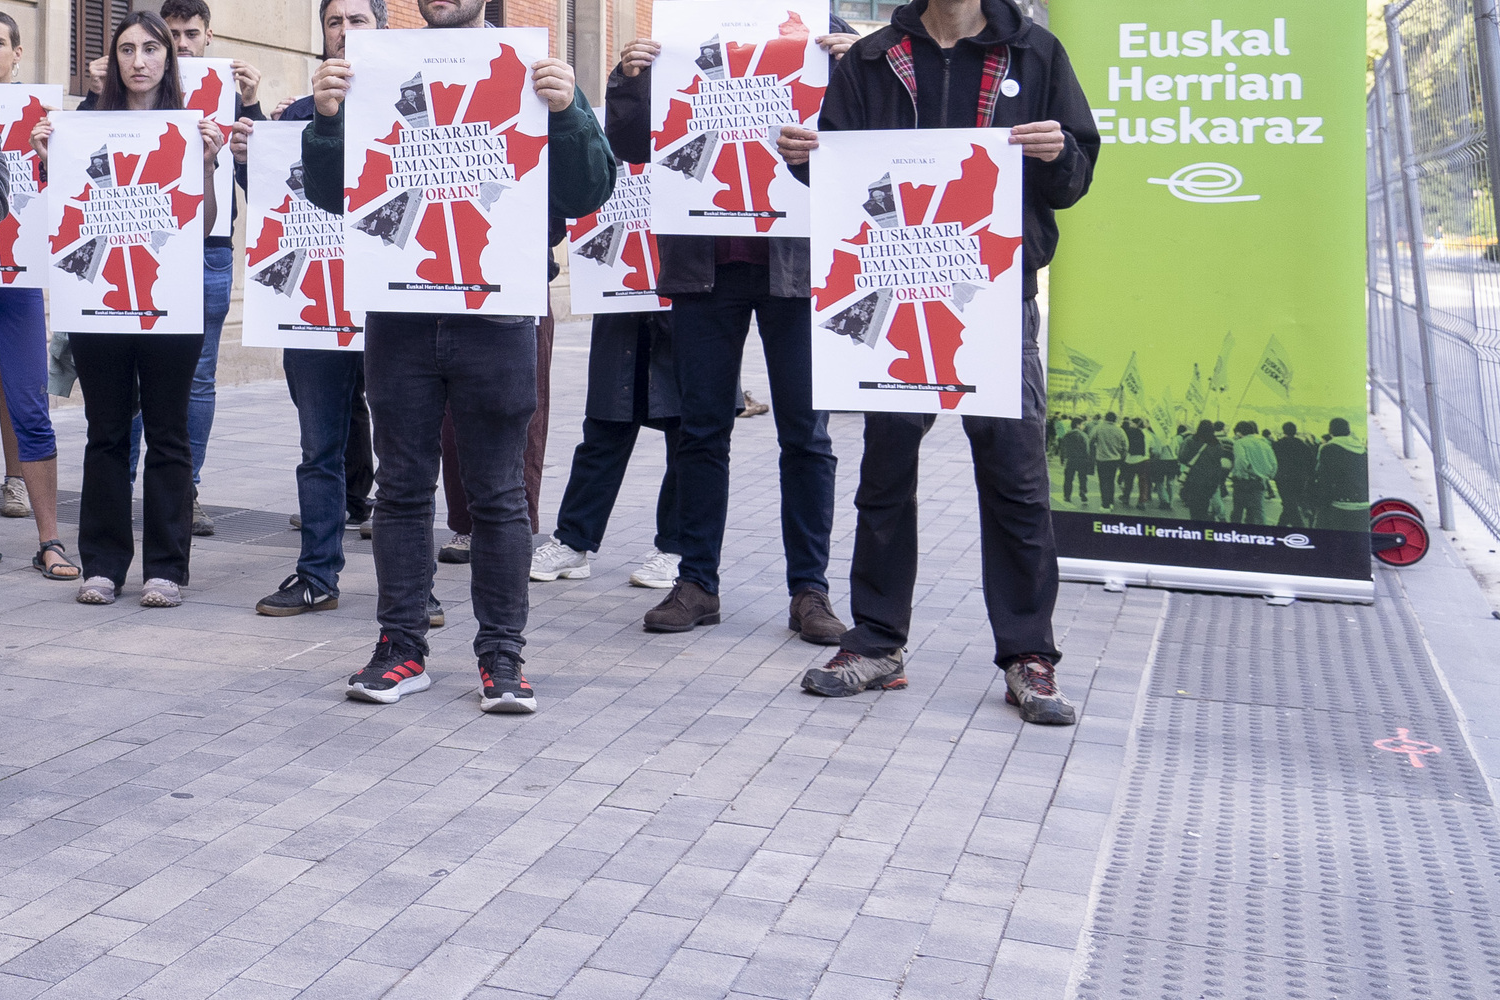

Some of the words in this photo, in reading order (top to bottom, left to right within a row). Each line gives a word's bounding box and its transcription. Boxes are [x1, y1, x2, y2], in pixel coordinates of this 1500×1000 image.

[1119, 18, 1290, 58] Euskal
[701, 75, 776, 93] EUSKARARI
[1108, 62, 1302, 101] Herrian
[692, 86, 790, 106] LEHENTASUNA
[695, 103, 751, 119] EMANEN
[756, 99, 790, 113] DION
[689, 113, 799, 131] OFIZIALTASUNA,
[1090, 106, 1324, 145] Euskaraz
[401, 124, 489, 143] EUSKARARI
[721, 128, 768, 141] ORAIN!
[392, 137, 505, 159] LEHENTASUNA
[395, 156, 460, 173] EMANEN
[465, 151, 504, 167] DION
[11, 172, 30, 182] ION
[388, 167, 514, 188] OFIZIALTASUNA,
[615, 175, 650, 188] USKAR
[90, 186, 158, 200] EUSKARARI
[426, 185, 480, 200] ORAIN!
[83, 195, 170, 212] LEHENTASUNA
[603, 197, 650, 212] EMANEN
[86, 211, 136, 224] EMANEN
[140, 207, 170, 218] DION
[284, 212, 344, 224] LEHENTAS
[598, 207, 651, 223] OFIZIALT
[80, 218, 178, 236] OFIZIALTASUNA,
[286, 223, 336, 236] EMANEN
[626, 220, 650, 230] ORA
[870, 223, 961, 243] EUSKARARI
[109, 234, 151, 246] ORAIN!
[280, 235, 344, 248] OFIZIALTAS
[860, 237, 978, 259] LEHENTASUNA
[309, 247, 344, 259] ORAIN
[863, 255, 932, 274] EMANEN
[936, 252, 977, 268] DION
[857, 268, 989, 288] OFIZIALTASUNA,
[896, 284, 952, 301] ORAIN!
[1093, 521, 1143, 536] Euskal
[1145, 524, 1201, 540] Herrian
[1204, 529, 1274, 546] Euskaraz
